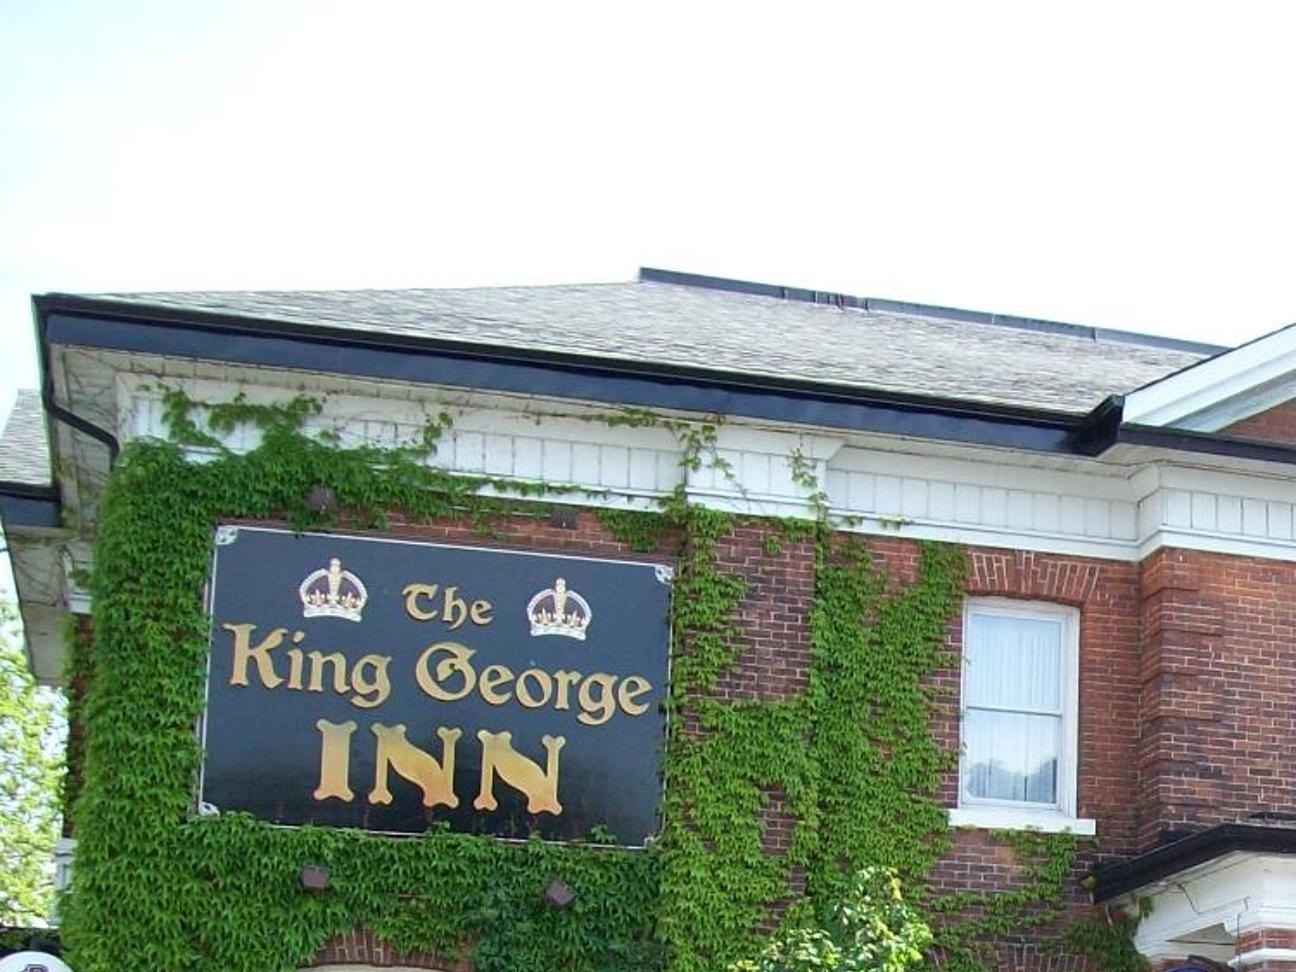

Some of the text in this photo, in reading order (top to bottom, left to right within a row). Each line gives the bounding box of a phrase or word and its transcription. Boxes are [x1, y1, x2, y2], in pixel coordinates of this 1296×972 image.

[403, 582, 495, 630] The
[223, 622, 654, 726] King George
[313, 717, 567, 817] INN
